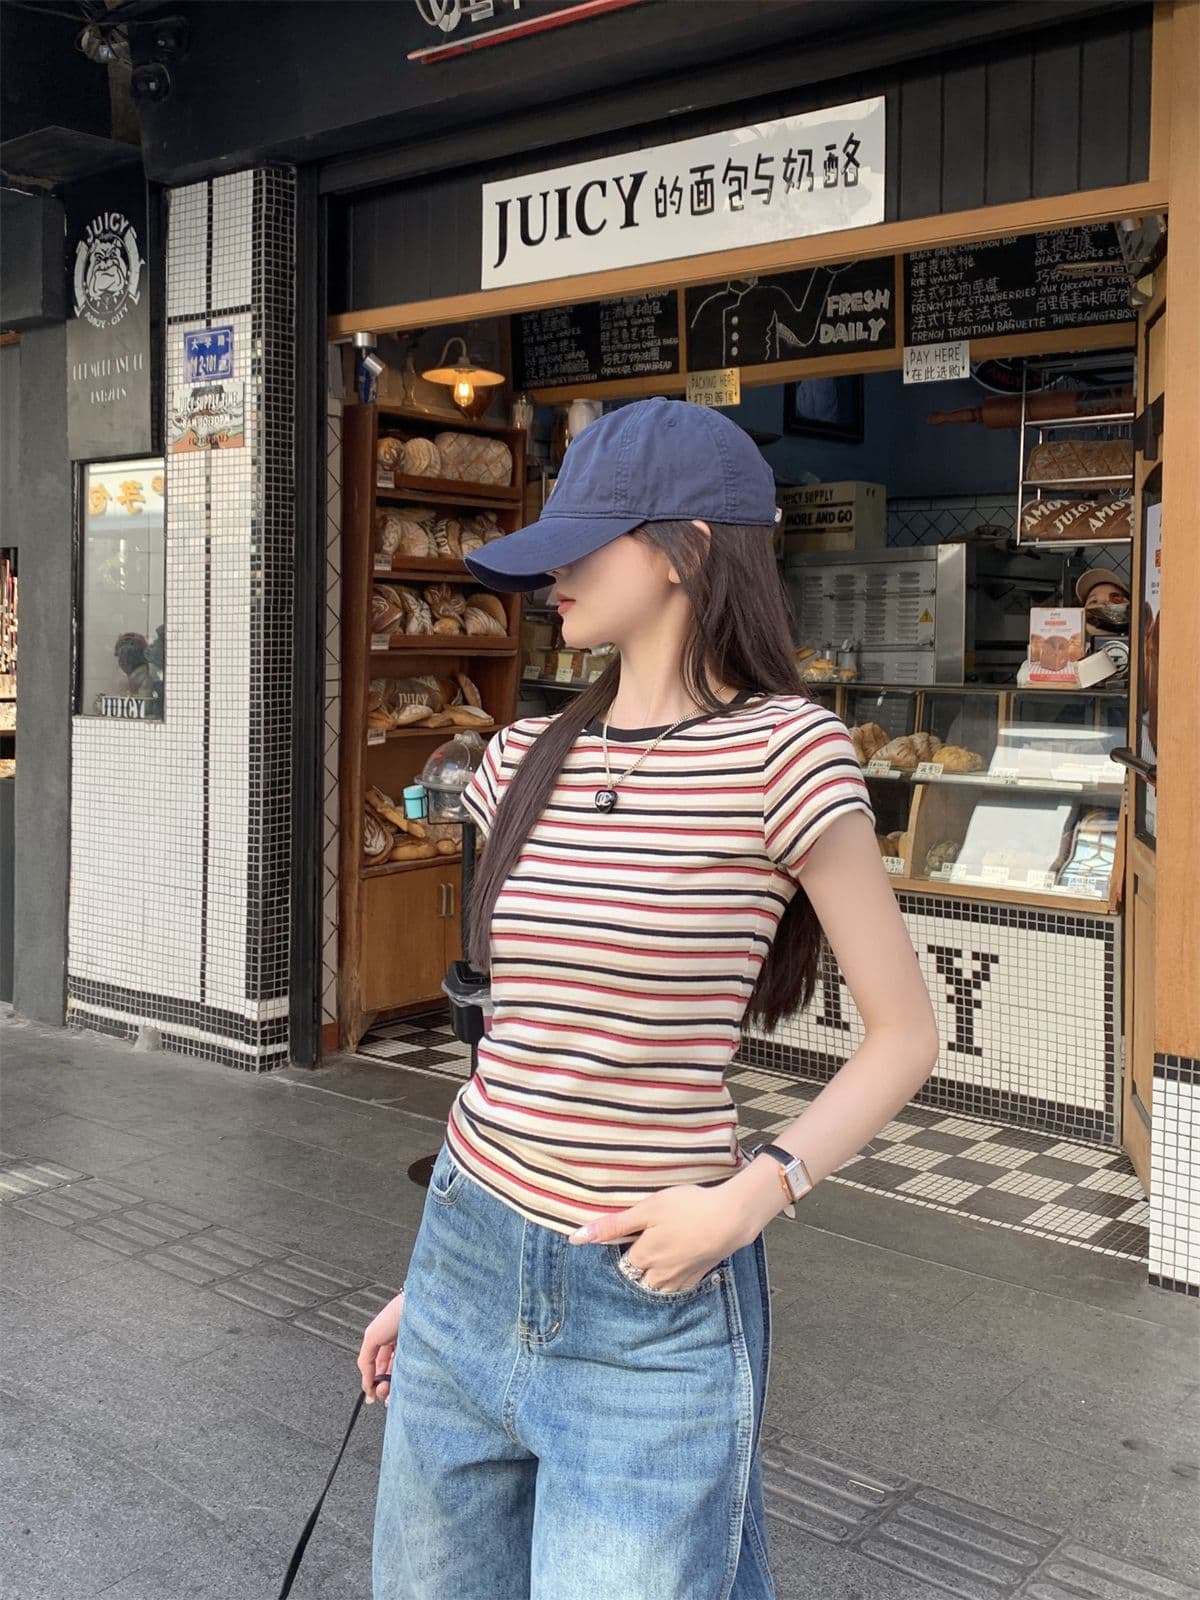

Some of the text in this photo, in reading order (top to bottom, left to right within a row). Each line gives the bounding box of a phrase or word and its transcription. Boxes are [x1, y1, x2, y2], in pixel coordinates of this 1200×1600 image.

[493, 132, 861, 269] JUICY 的面包与奶酪
[86, 212, 129, 243] JUICY
[930, 272, 965, 286] WALNUT
[826, 288, 890, 318] FRESH
[911, 287, 1037, 314] FRENCH WINE STRAWBERRIES
[110, 303, 129, 326] CITY
[819, 317, 886, 345] DAILY
[911, 317, 1046, 343] FRENCH TRADITION BAGUETTE
[910, 347, 960, 365] PAY HERE
[911, 364, 961, 382] 在此选购
[805, 488, 834, 504] SUPPLY
[815, 511, 836, 525] AND
[837, 509, 853, 524] GO
